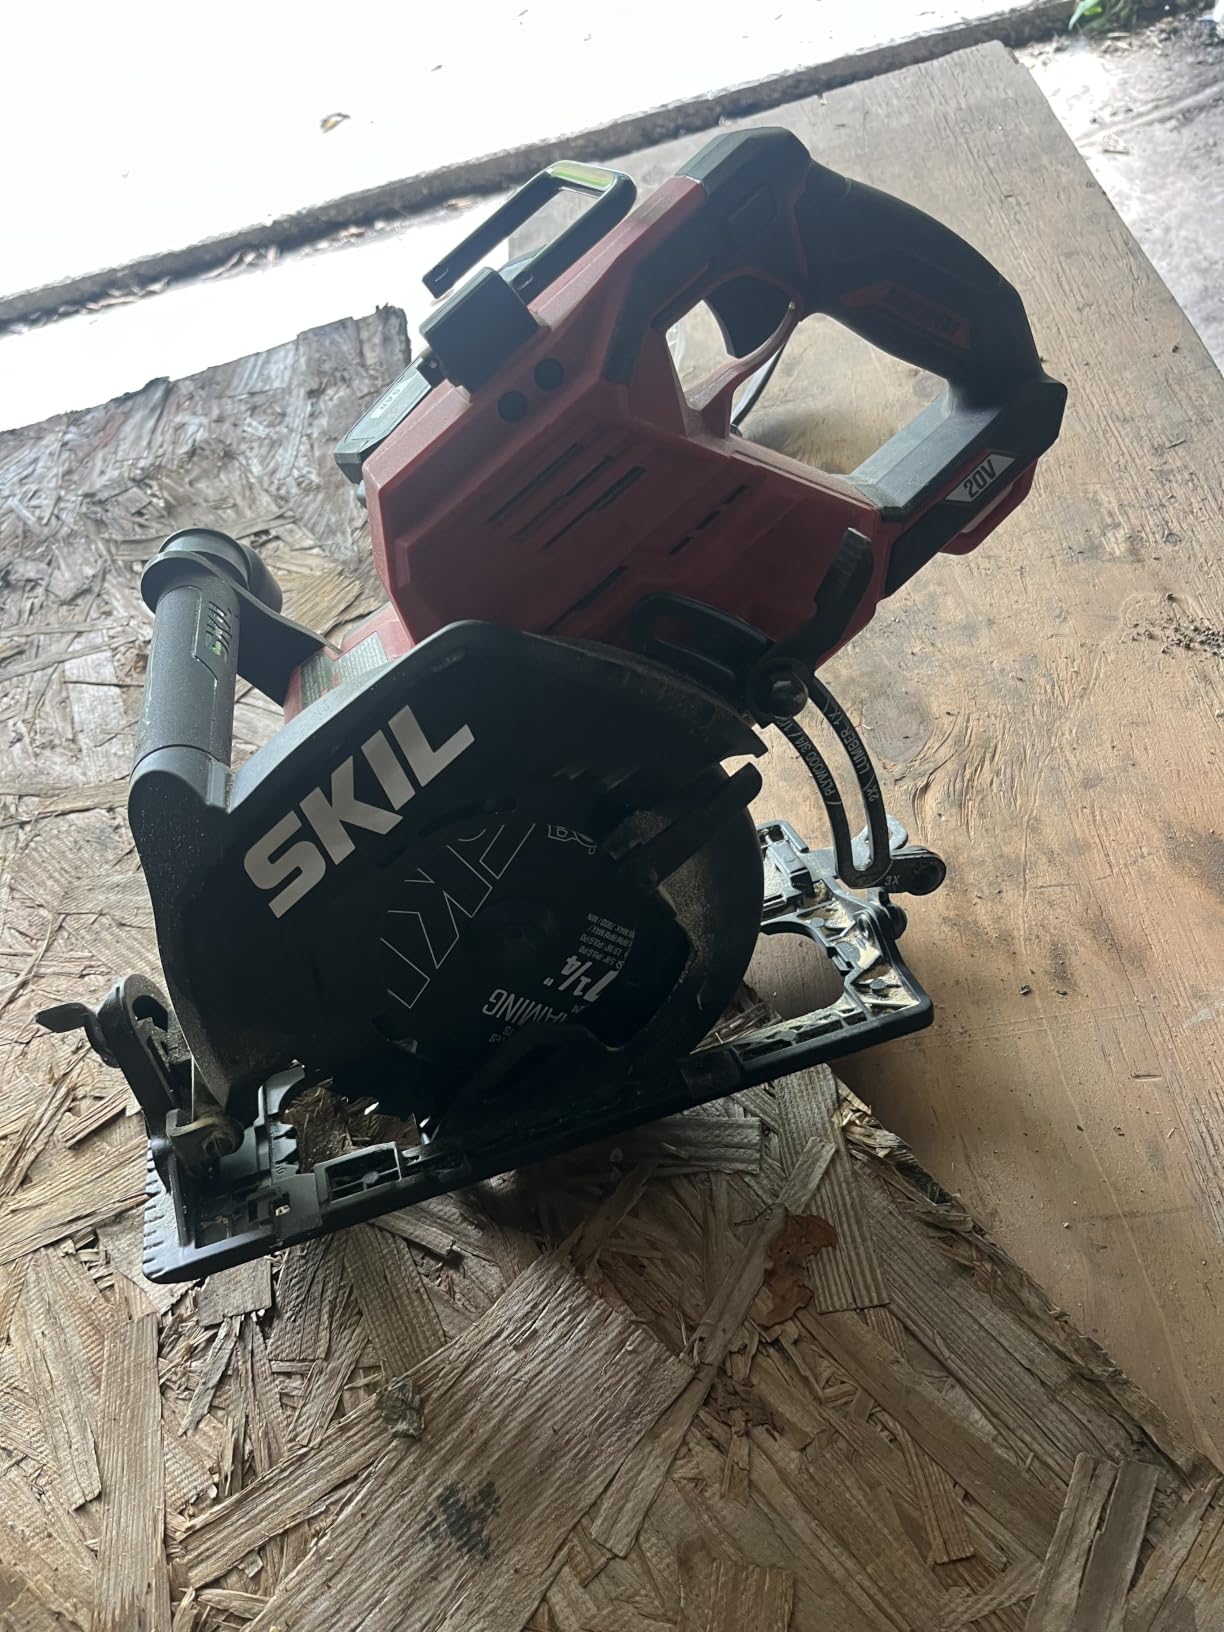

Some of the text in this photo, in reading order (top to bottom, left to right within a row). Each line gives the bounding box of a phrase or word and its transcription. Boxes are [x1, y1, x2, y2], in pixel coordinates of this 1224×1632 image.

[962, 458, 996, 499] 20V
[795, 735, 812, 754] 3/4
[828, 709, 881, 802] 2X LUMBER 1X
[805, 750, 837, 798] PLYWOOD
[243, 704, 476, 919] SKIL
[884, 874, 901, 886] 3X
[481, 988, 568, 1025] AMING
